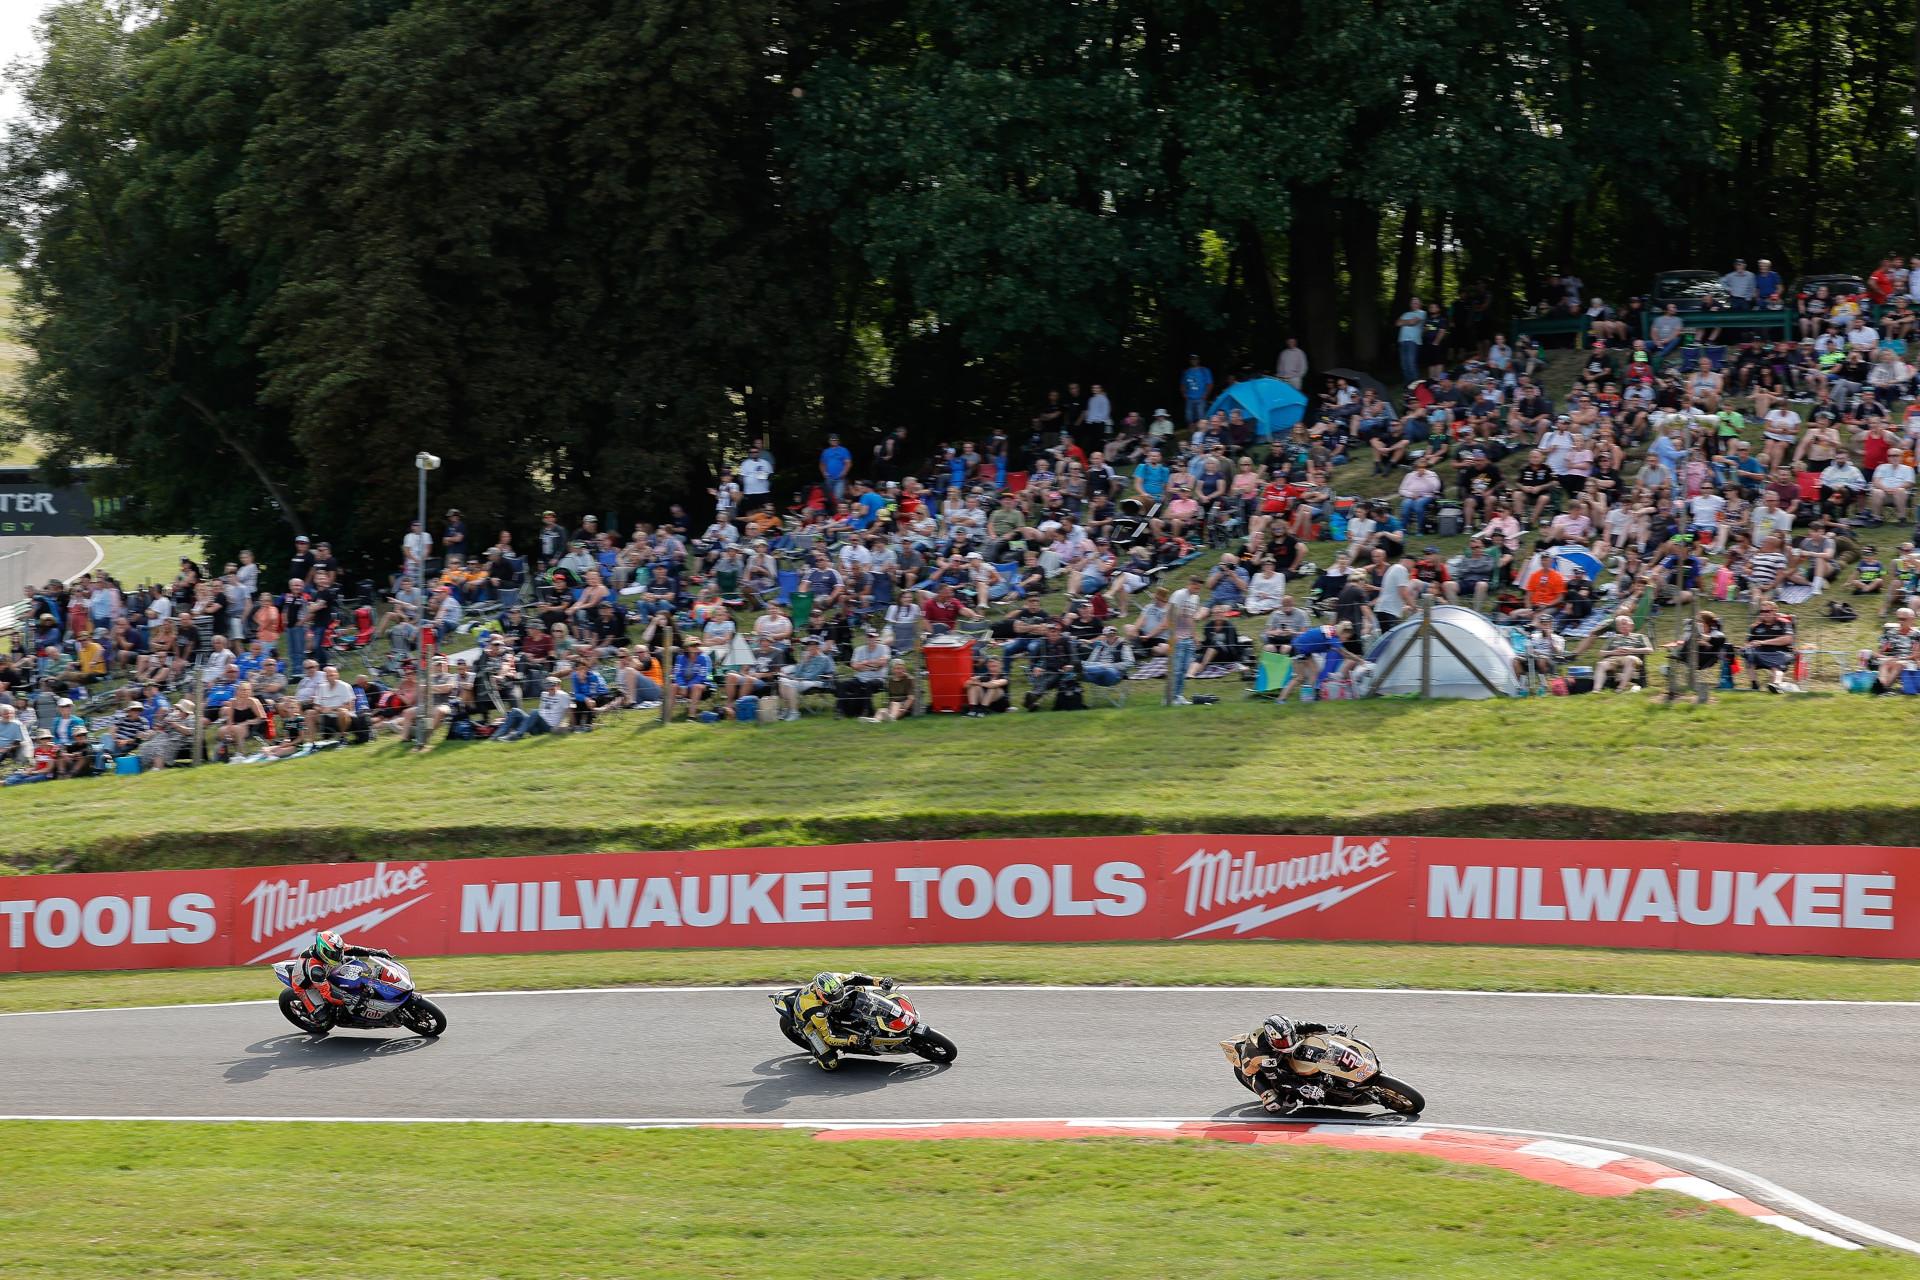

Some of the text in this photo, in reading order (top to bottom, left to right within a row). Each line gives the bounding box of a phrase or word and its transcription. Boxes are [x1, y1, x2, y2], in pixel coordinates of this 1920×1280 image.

[242, 862, 429, 943] Milwaukee
[459, 861, 1147, 933] MILWAUKEE TOOLS
[1173, 836, 1391, 916] Milwaukee
[1427, 864, 1896, 930] MILWAUKEE
[0, 893, 217, 949] TOOLS
